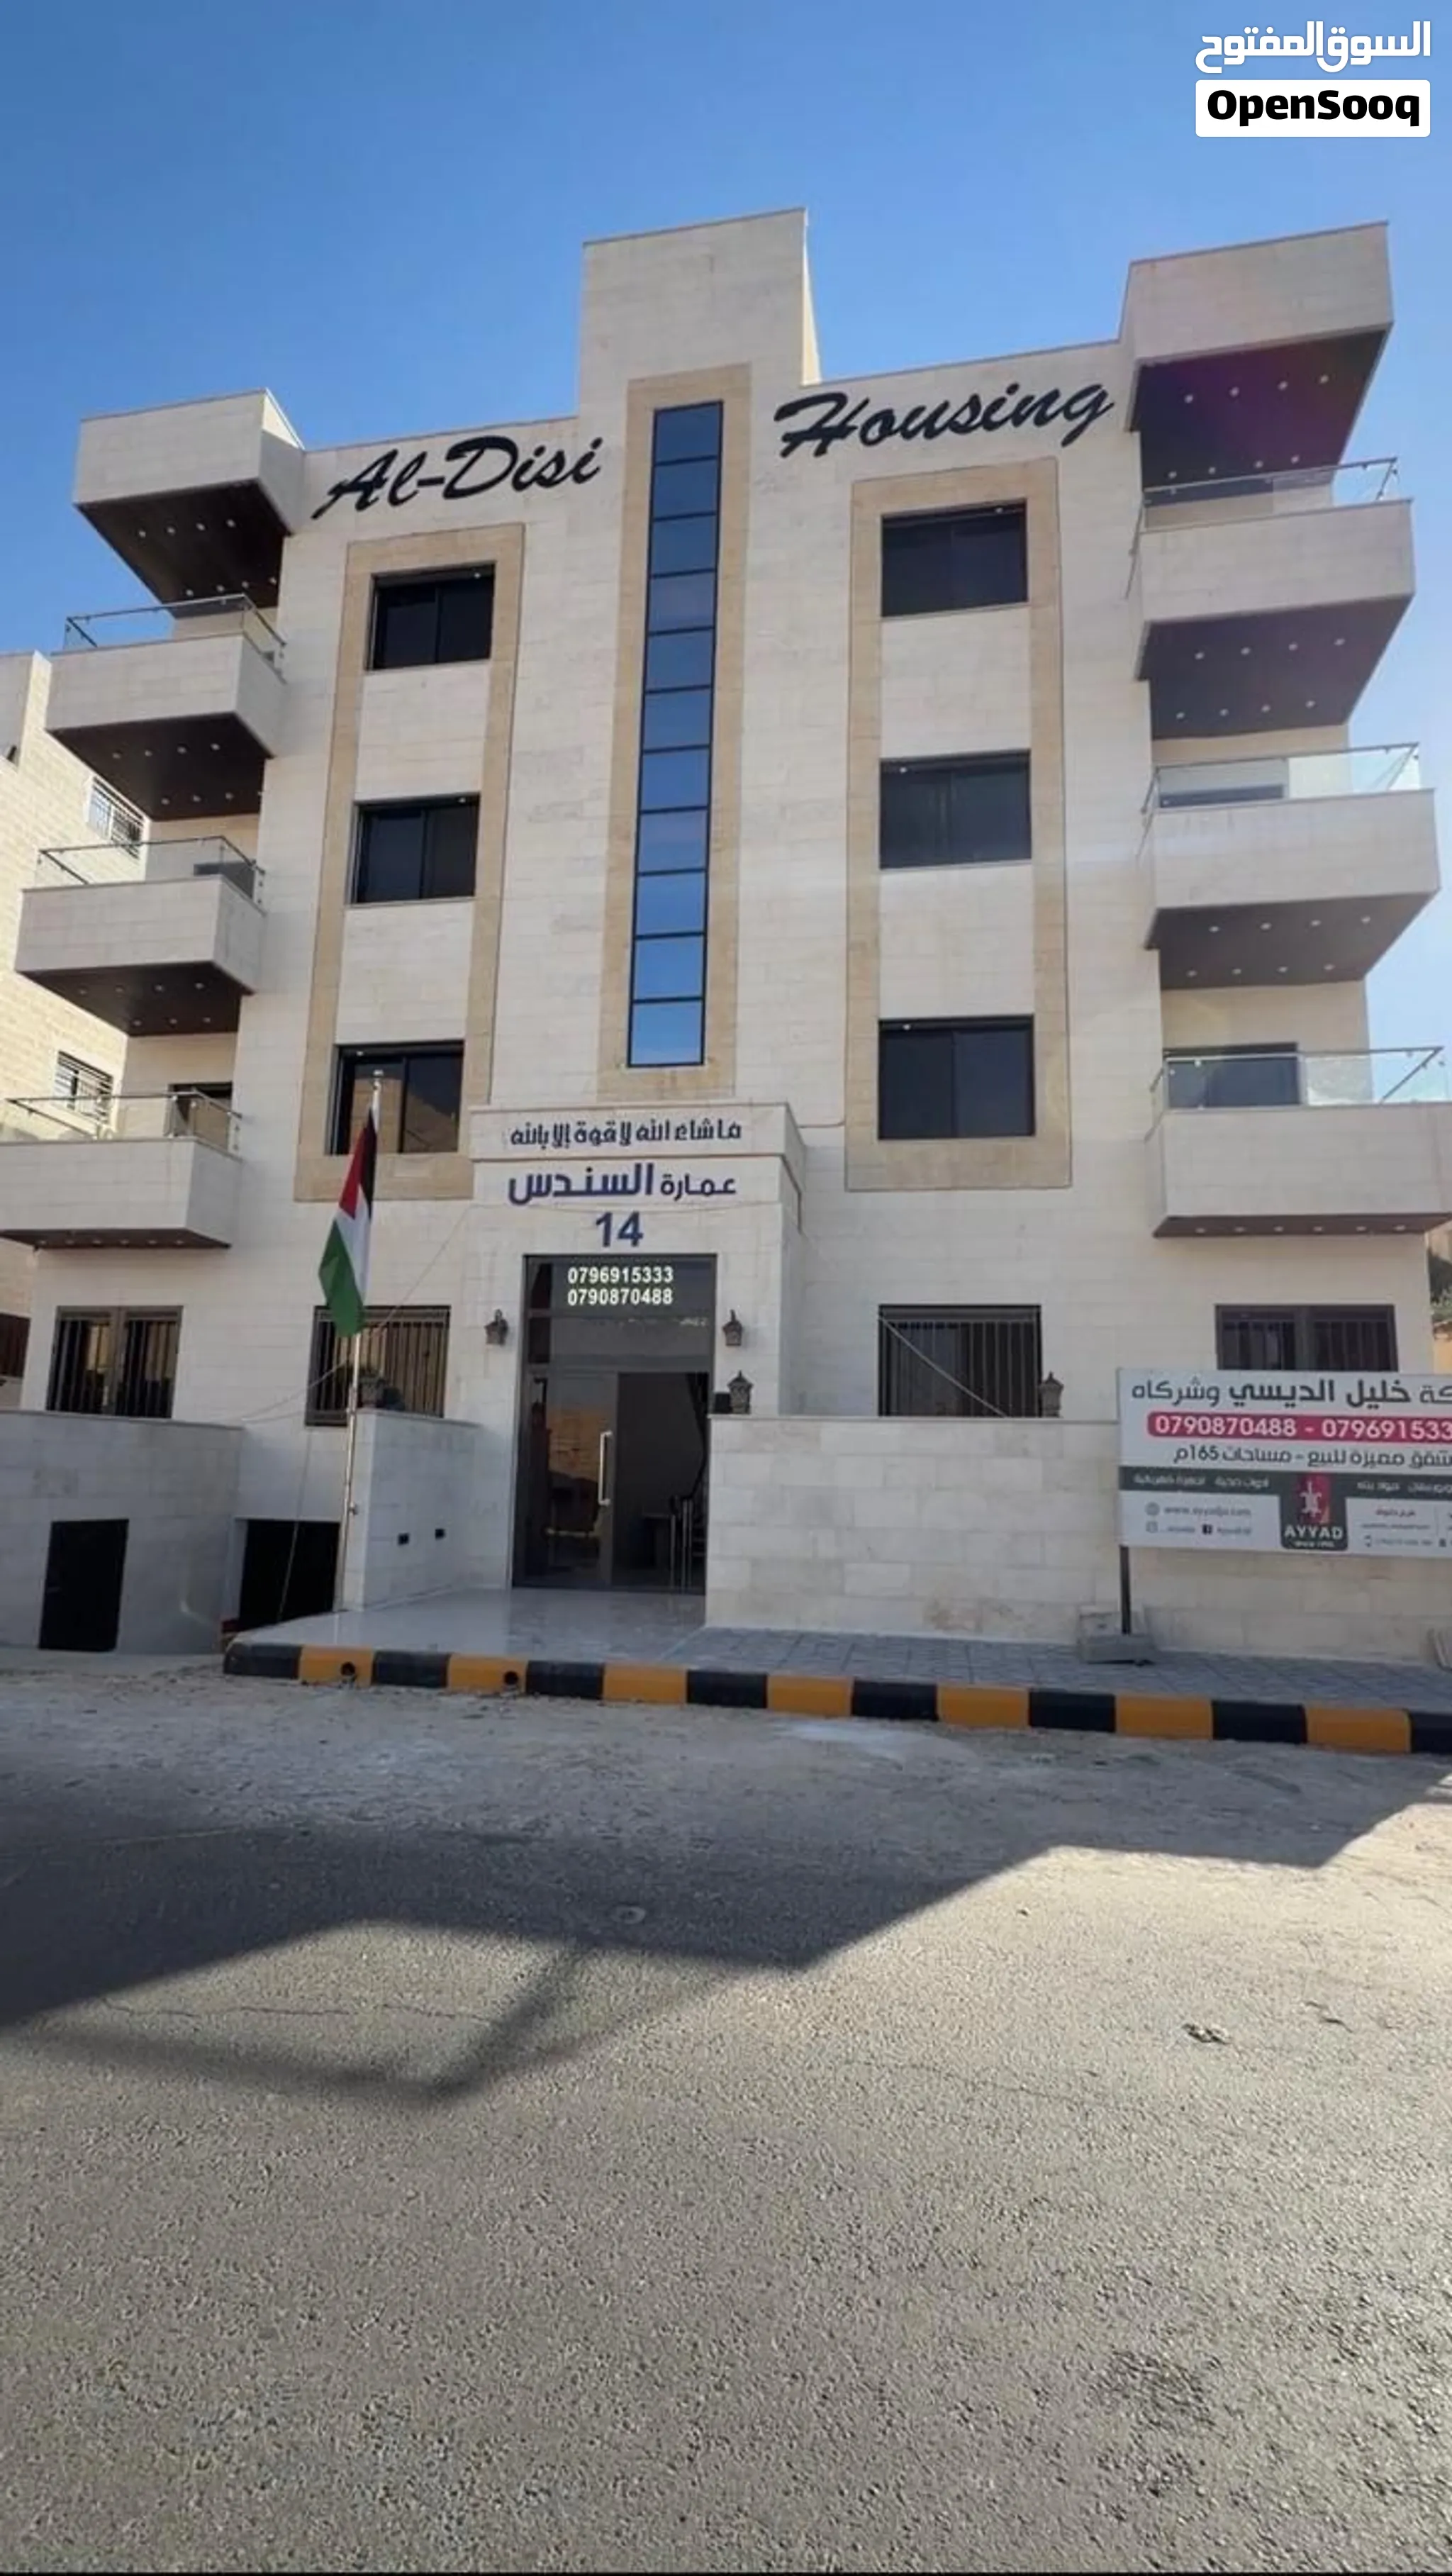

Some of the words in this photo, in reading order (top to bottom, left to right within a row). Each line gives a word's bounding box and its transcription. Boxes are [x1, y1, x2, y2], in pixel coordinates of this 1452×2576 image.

[311, 435, 603, 520] Al-Disi
[774, 381, 1115, 459] Housing
[510, 1122, 549, 1150] بالله
[574, 1120, 618, 1147] قوة
[619, 1120, 632, 1147] لا
[636, 1117, 670, 1142] الله
[508, 1162, 654, 1205] السندس
[659, 1173, 737, 1201] عمارة
[596, 1210, 644, 1248] 14
[567, 1266, 674, 1284] 0796915333
[567, 1288, 674, 1306] 0790870488
[1132, 1376, 1220, 1407] وشركاه
[1229, 1379, 1335, 1408] الديسي
[1346, 1379, 1412, 1410] خليل
[1155, 1415, 1297, 1437] 0790870488
[1222, 1445, 1292, 1463] مساحات
[1307, 1448, 1346, 1468] للبيع
[1349, 1450, 1405, 1468] مميزة
[1284, 1524, 1344, 1540] AYYAD
